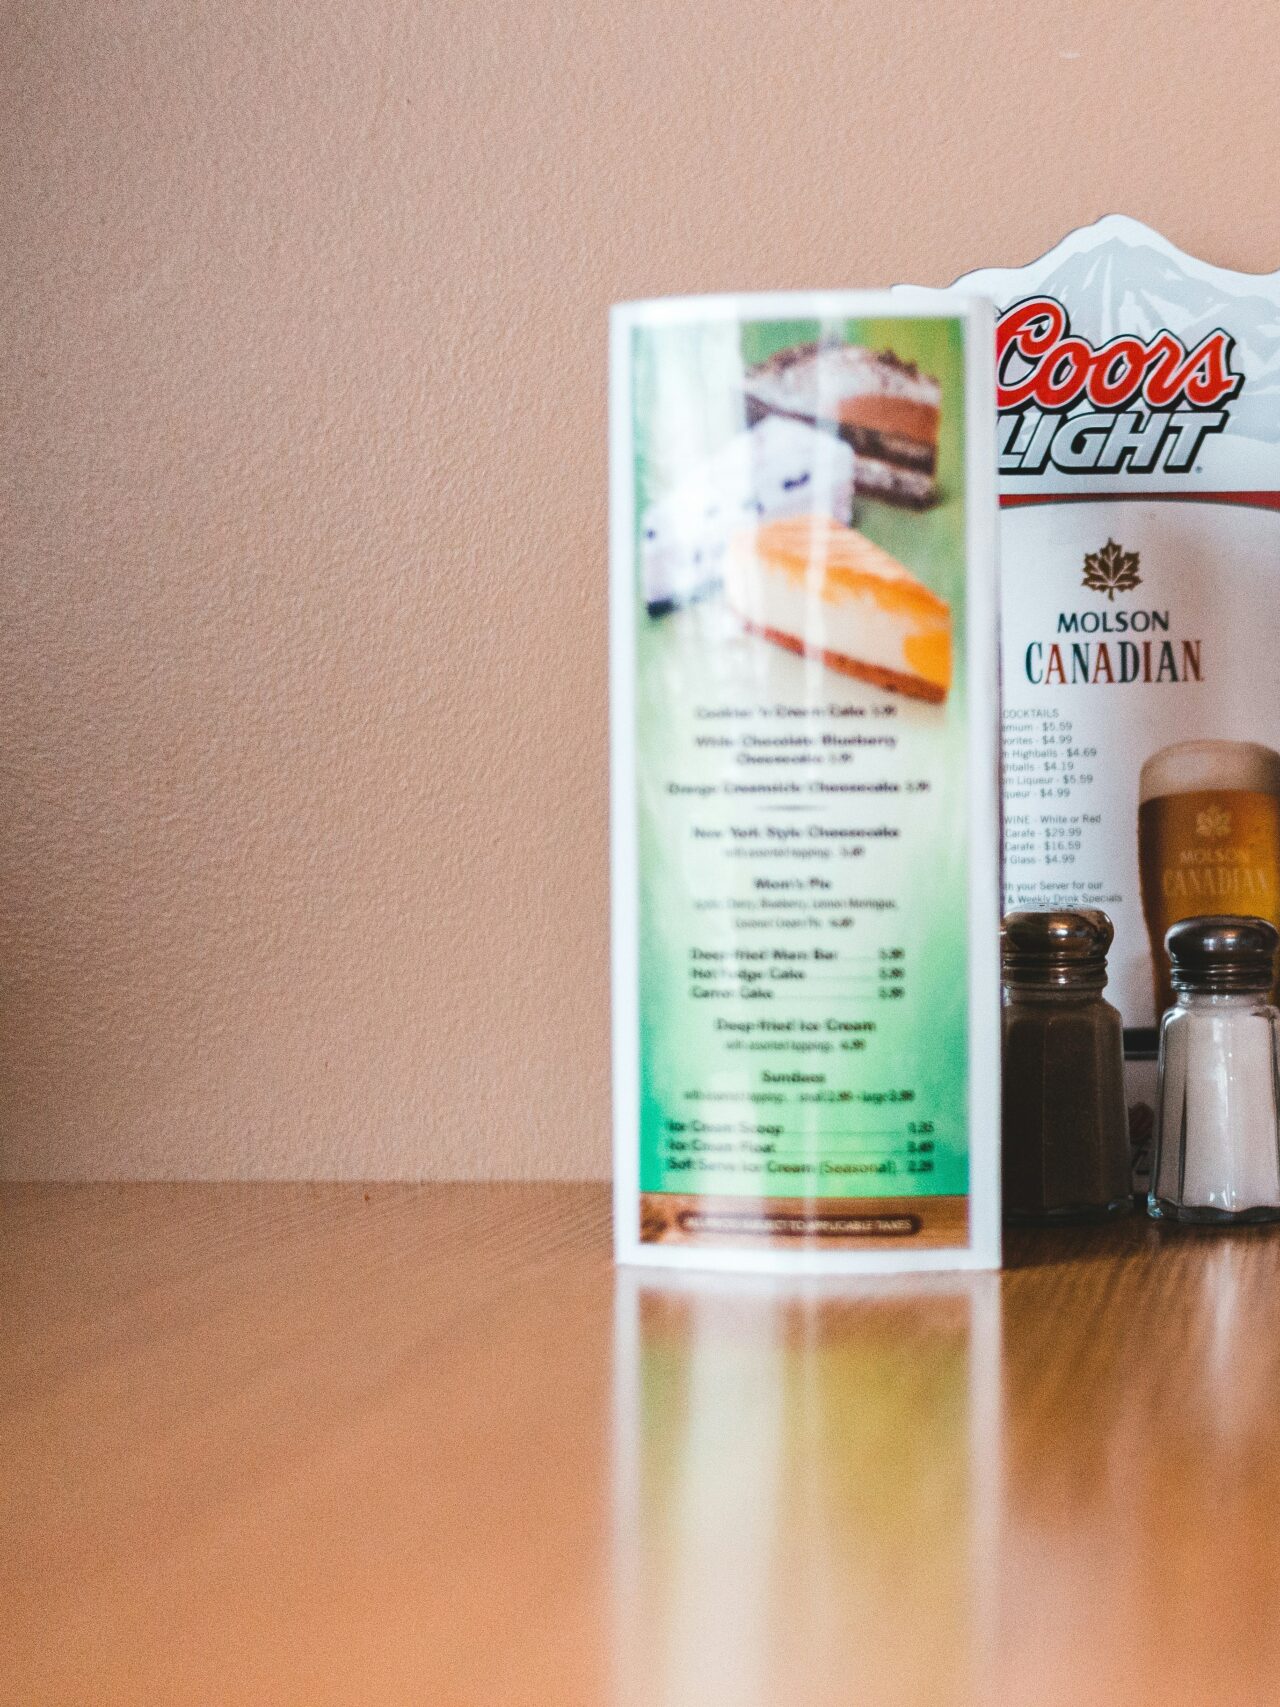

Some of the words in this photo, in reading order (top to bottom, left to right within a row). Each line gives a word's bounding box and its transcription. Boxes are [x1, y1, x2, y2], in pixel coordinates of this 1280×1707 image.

[995, 294, 1244, 416] Coors
[996, 409, 1230, 475] LIGHT
[1057, 609, 1170, 633] MOLSON
[1025, 639, 1205, 685] CANADIAN
[1042, 734, 1073, 745] $4.99
[1012, 749, 1058, 760] Highballs
[1067, 748, 1097, 758] $4.69
[1017, 775, 1054, 786] Liqueur
[1003, 815, 1030, 824] WINE
[1040, 815, 1067, 824] White
[1082, 814, 1101, 824] Red
[1010, 855, 1036, 864] Glass
[1045, 854, 1075, 864] $4.99
[1179, 848, 1251, 865] MOLSON
[1017, 883, 1037, 892] your
[1040, 881, 1069, 890] Server
[1072, 881, 1085, 890] for
[1087, 882, 1103, 890] our
[1163, 868, 1271, 898] CANADIAN
[1008, 896, 1014, 904] &
[1018, 895, 1051, 906] Weekly
[1054, 895, 1079, 904] Drink
[1082, 894, 1123, 905] Specials
